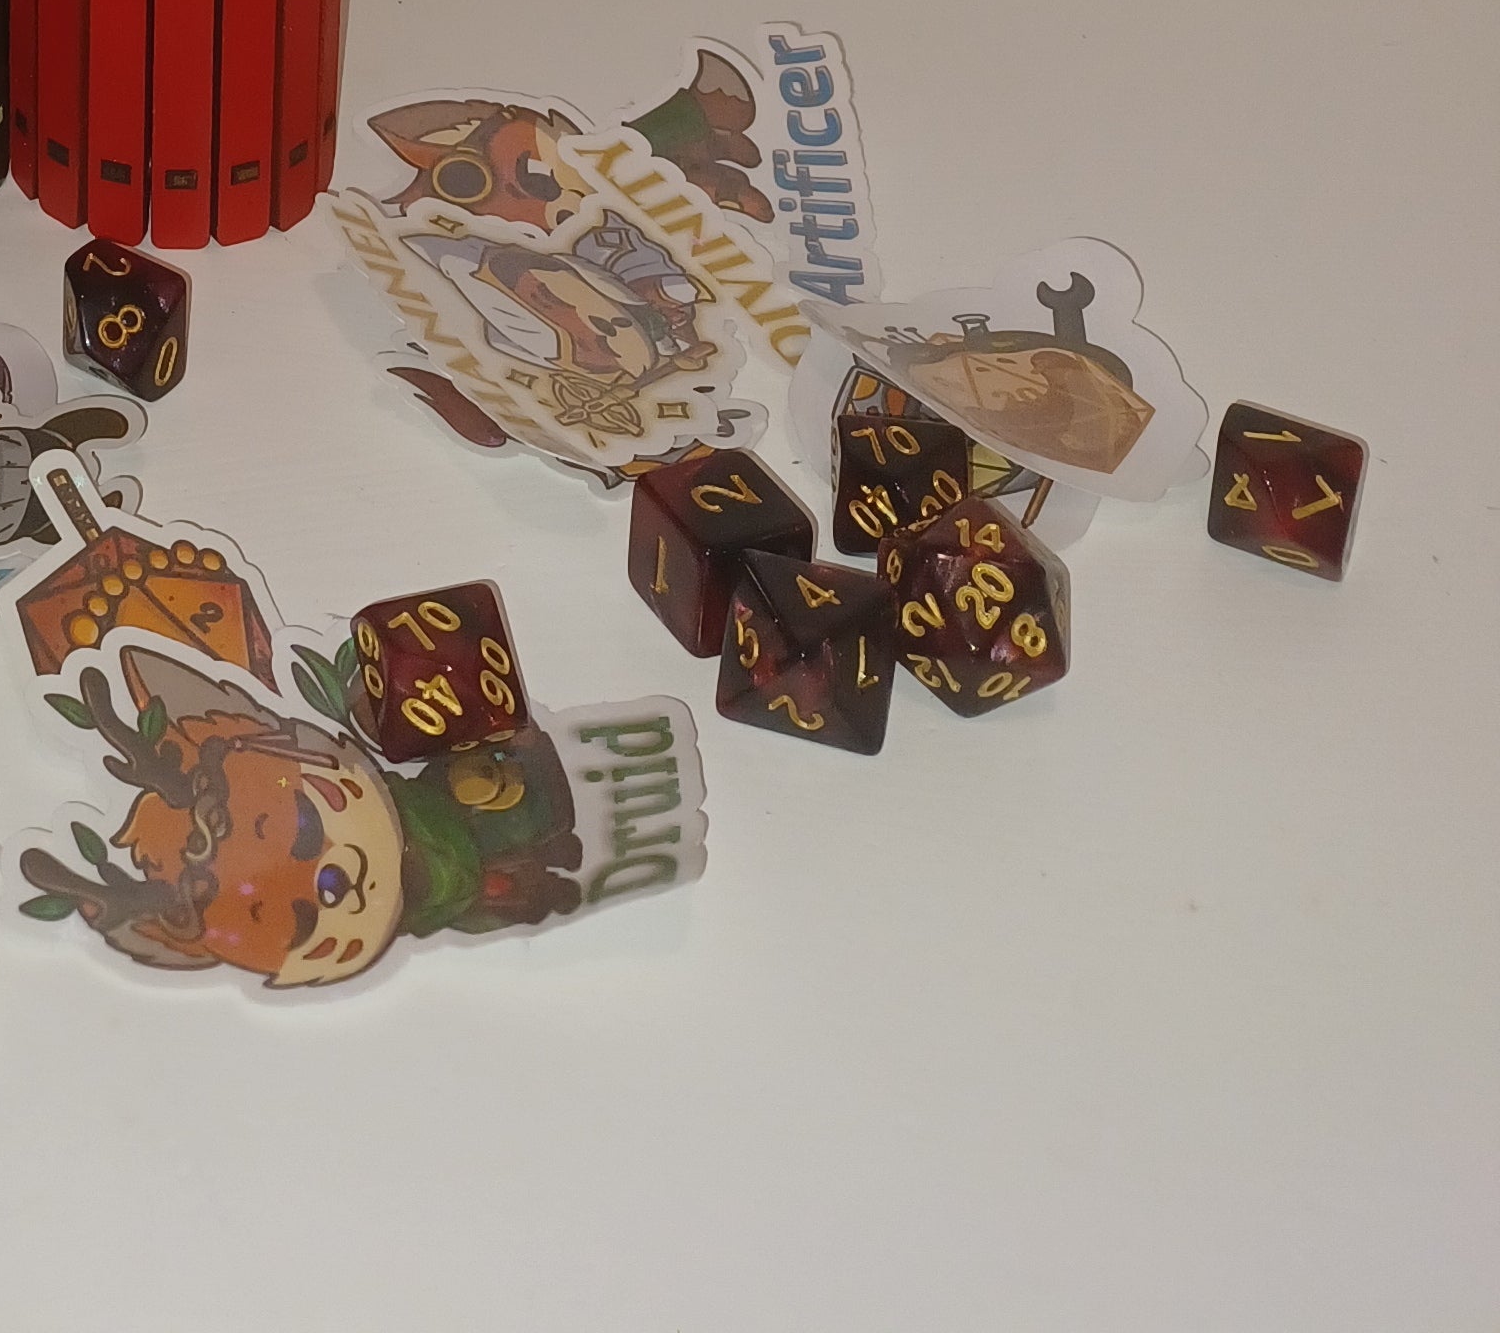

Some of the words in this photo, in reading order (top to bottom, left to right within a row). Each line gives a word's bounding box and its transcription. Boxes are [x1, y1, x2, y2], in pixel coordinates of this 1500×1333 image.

[767, 34, 866, 304] Artificer
[98, 304, 145, 349] 8
[851, 425, 921, 465] 70
[691, 474, 763, 513] 2
[955, 518, 1005, 553] 14
[796, 574, 841, 608] 4
[955, 562, 1015, 630] 20
[388, 601, 461, 650] 70
[902, 592, 945, 637] 2
[1010, 612, 1048, 658] 8
[401, 674, 463, 736] 40
[768, 695, 824, 730] 2
[579, 715, 681, 903] Druid
